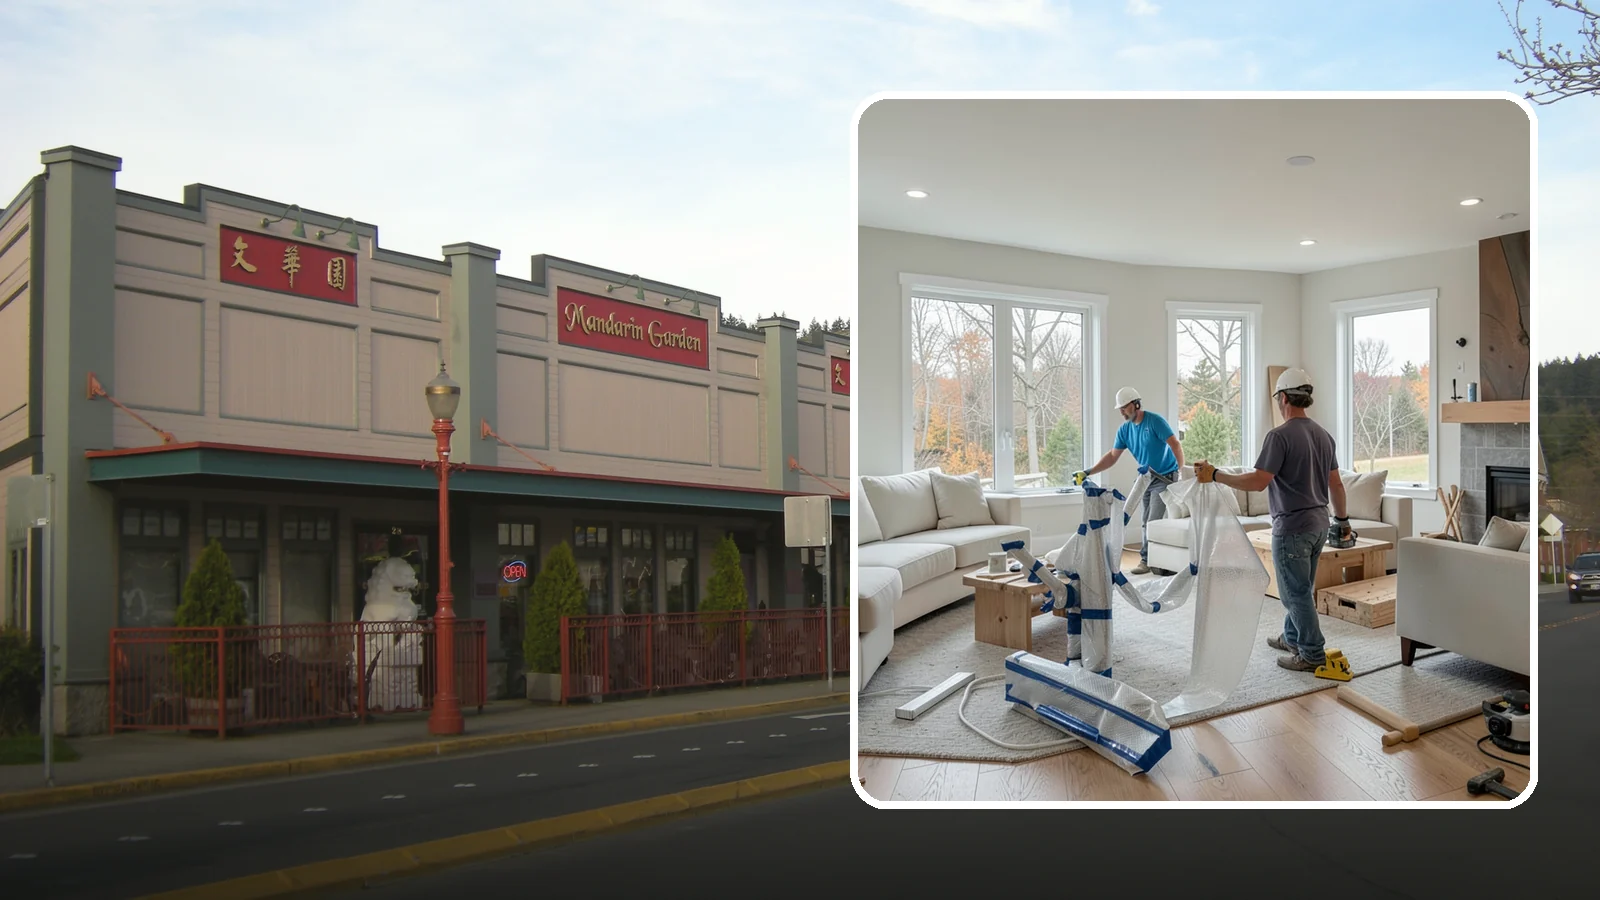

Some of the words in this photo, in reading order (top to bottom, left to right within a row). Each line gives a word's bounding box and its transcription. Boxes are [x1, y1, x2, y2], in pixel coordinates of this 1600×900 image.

[564, 302, 644, 341] Mandarin
[648, 320, 702, 352] Garden
[834, 363, 846, 386] 文
[503, 565, 527, 578] OPEN
